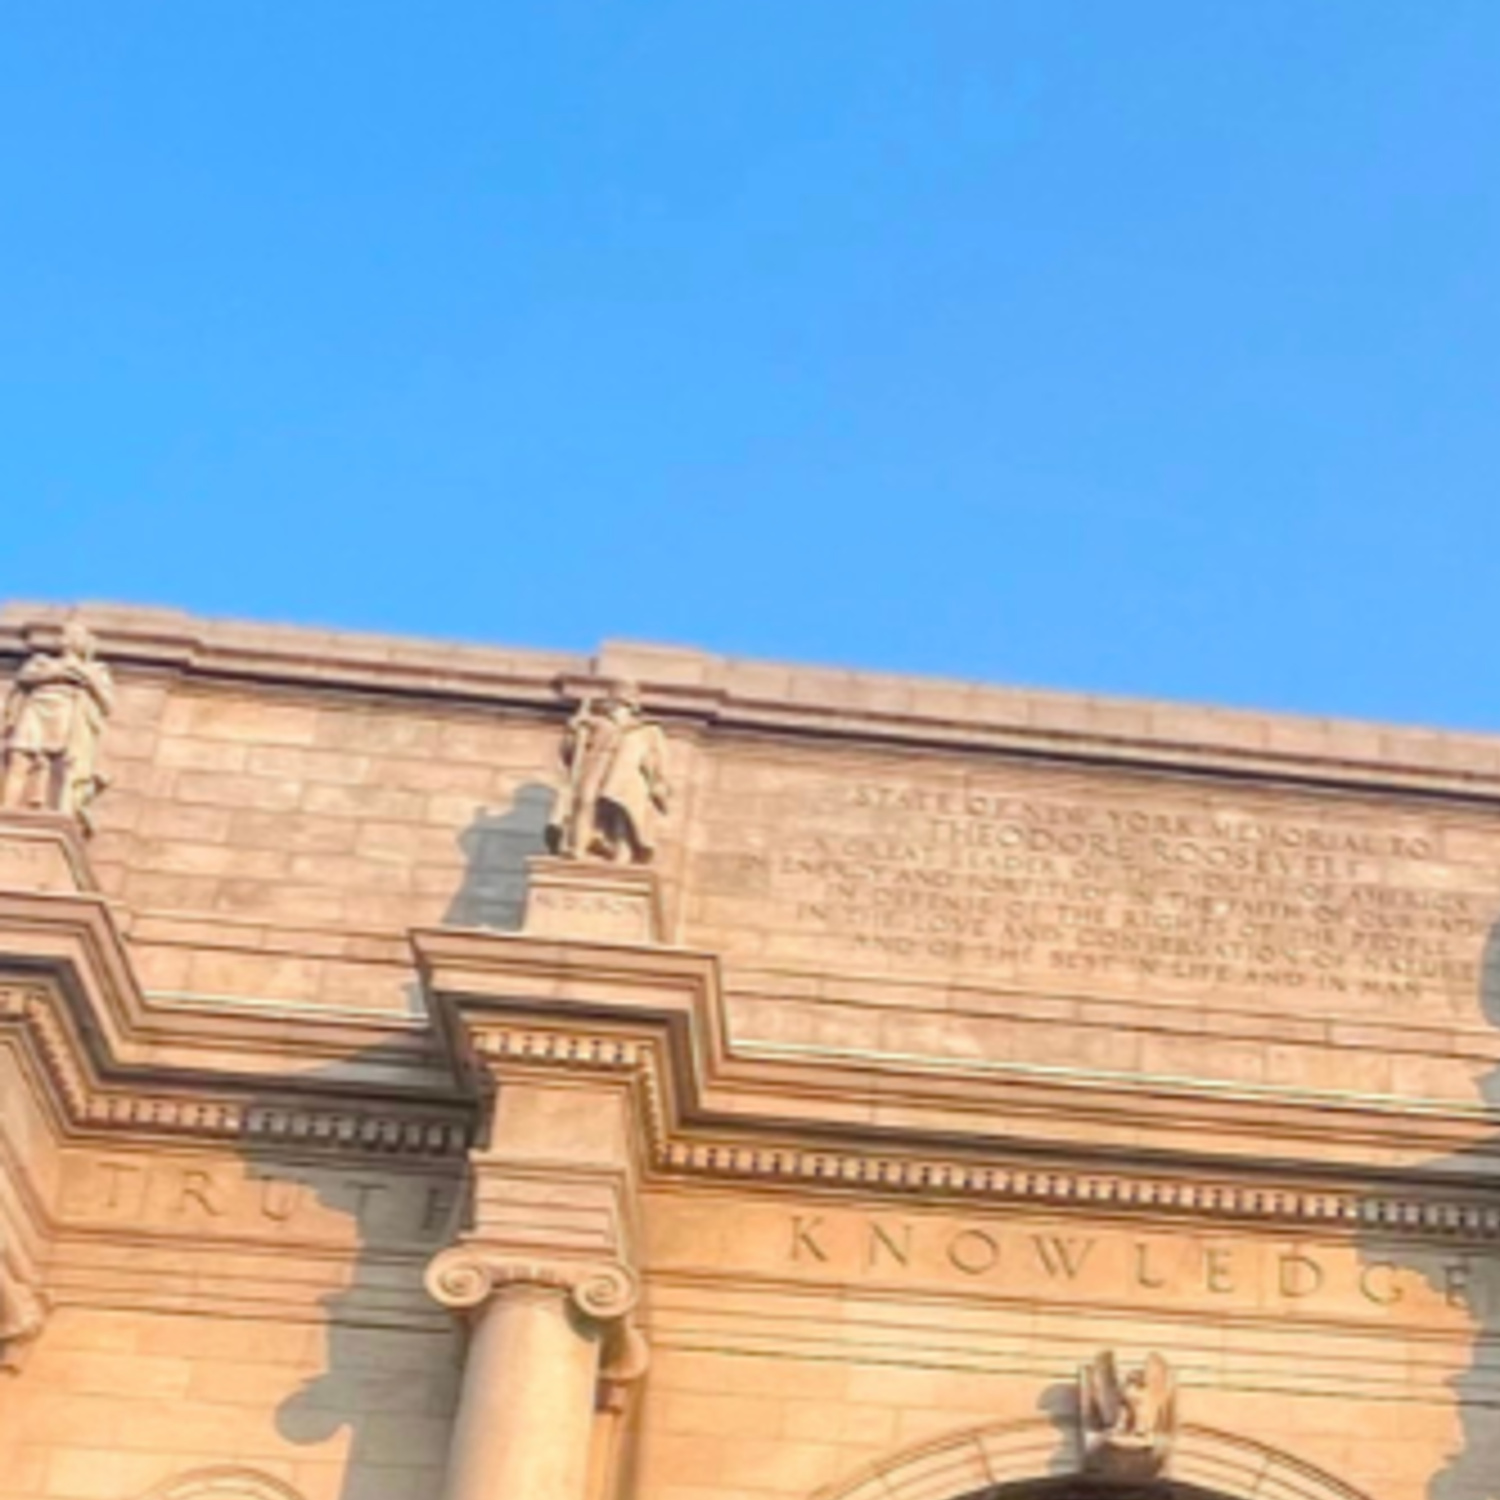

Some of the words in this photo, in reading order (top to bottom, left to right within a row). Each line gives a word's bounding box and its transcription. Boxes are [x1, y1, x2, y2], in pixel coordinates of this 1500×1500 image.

[928, 818, 1134, 862] THEODORE
[1152, 837, 1366, 880] ROOSEVELT
[1107, 809, 1196, 837] YORK
[1390, 836, 1431, 860] TO
[787, 1215, 1473, 1309] KNOWLEDGE
